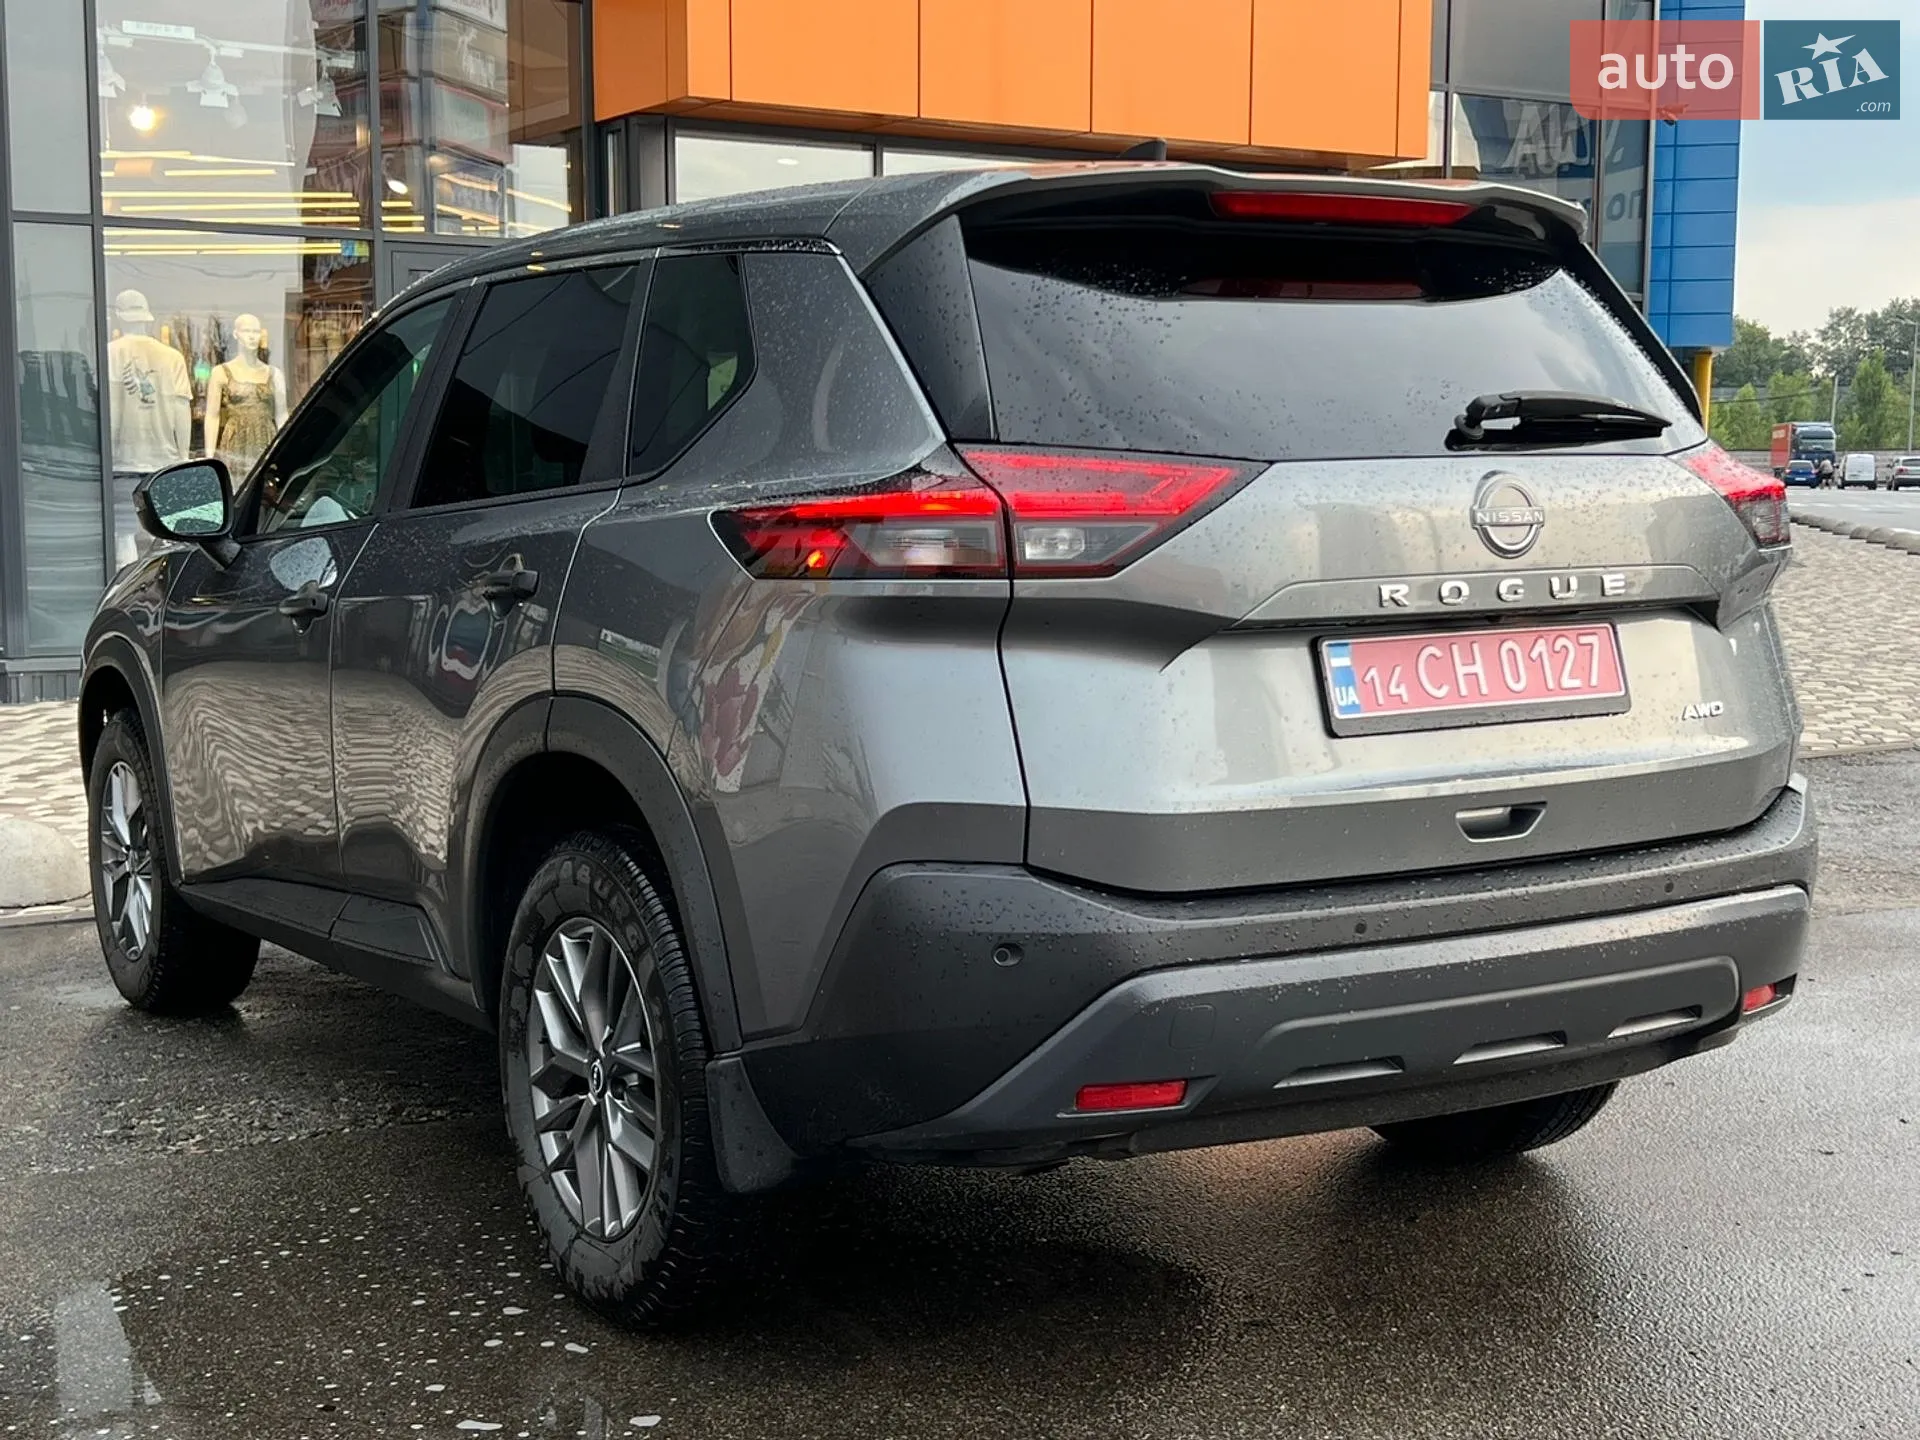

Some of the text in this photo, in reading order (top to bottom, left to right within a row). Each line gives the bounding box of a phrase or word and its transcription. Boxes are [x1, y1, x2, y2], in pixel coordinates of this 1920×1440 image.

[1476, 510, 1544, 523] NISSAN
[1379, 573, 1626, 608] ROGUE
[1363, 633, 1600, 706] 14 CH 0127
[1335, 686, 1359, 706] UA
[1682, 701, 1724, 720] AWD
